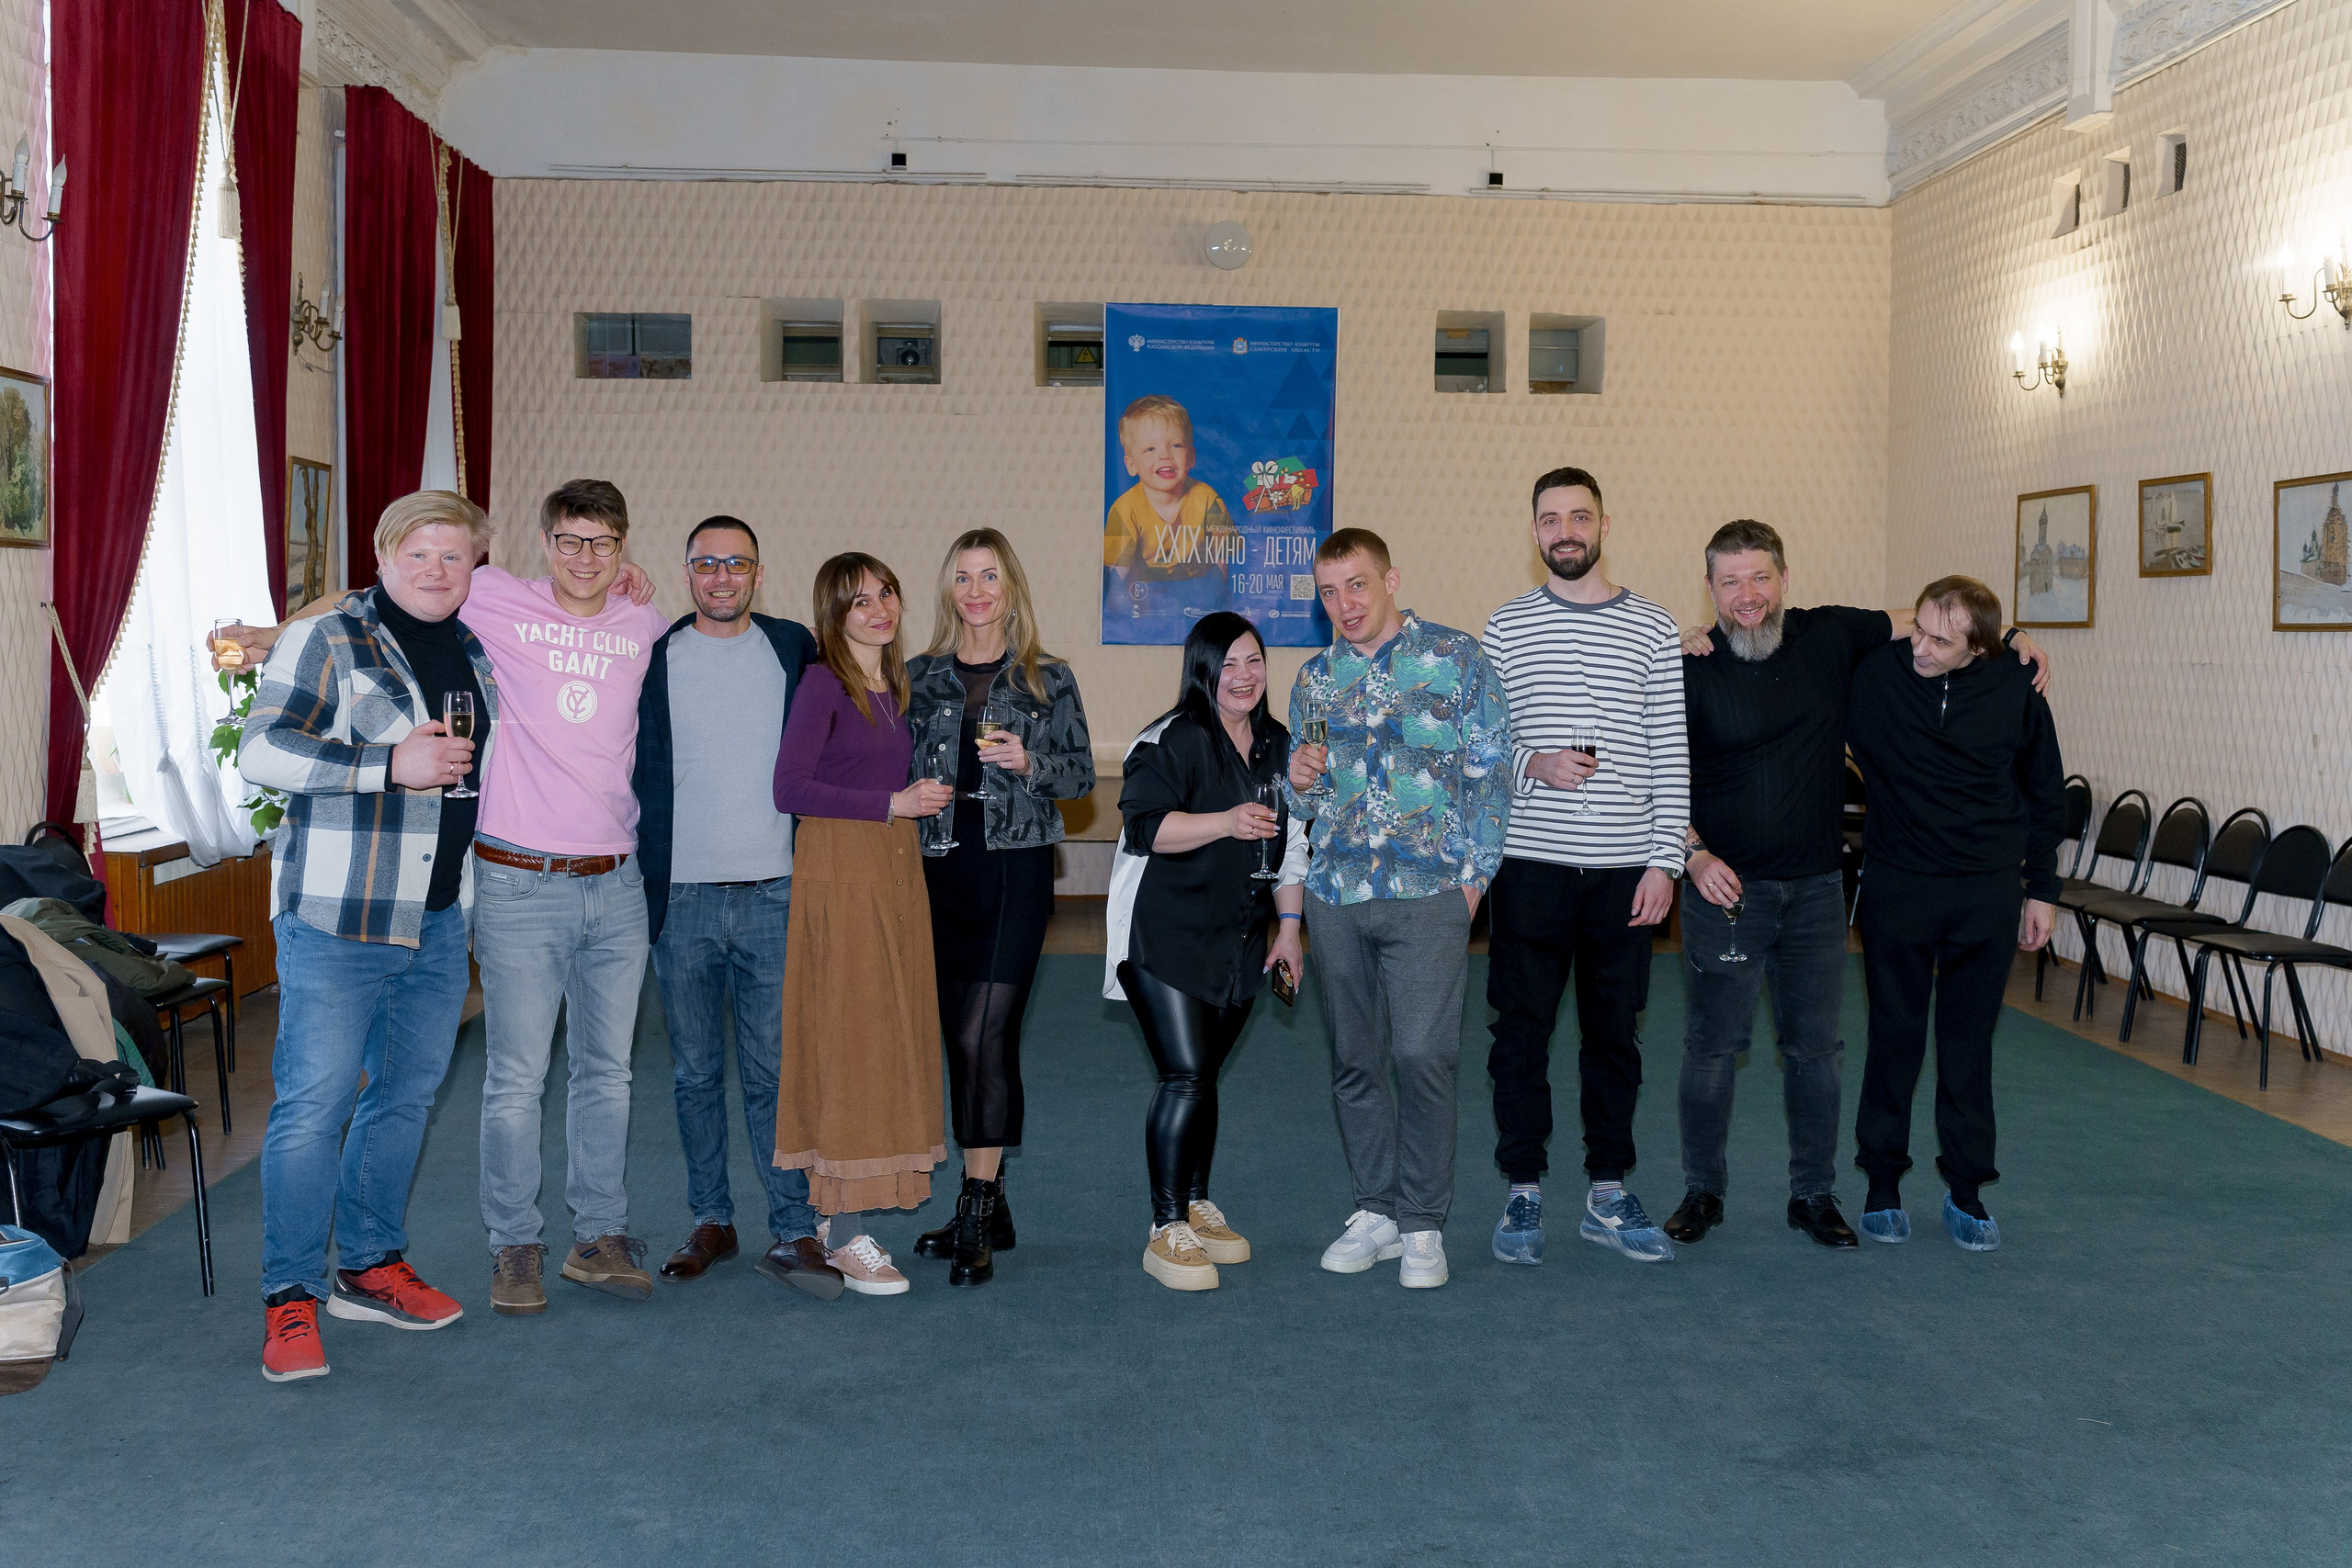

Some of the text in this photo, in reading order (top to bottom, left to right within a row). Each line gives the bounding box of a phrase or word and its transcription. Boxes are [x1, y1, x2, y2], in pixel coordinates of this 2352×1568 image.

[1154, 525, 1201, 564] XXIX
[1205, 525, 1316, 535] МЕЖДУНАРОДНЫЙ КИНОФЕСТИВАЛЬ
[1204, 536, 1246, 565] КИНО
[1263, 536, 1317, 569] ДЕТЯМ
[1135, 583, 1146, 598] 6+
[1231, 573, 1283, 594] 16-20 МАЯ
[514, 623, 639, 660] YACHT CLUB
[548, 649, 613, 680] GANT
